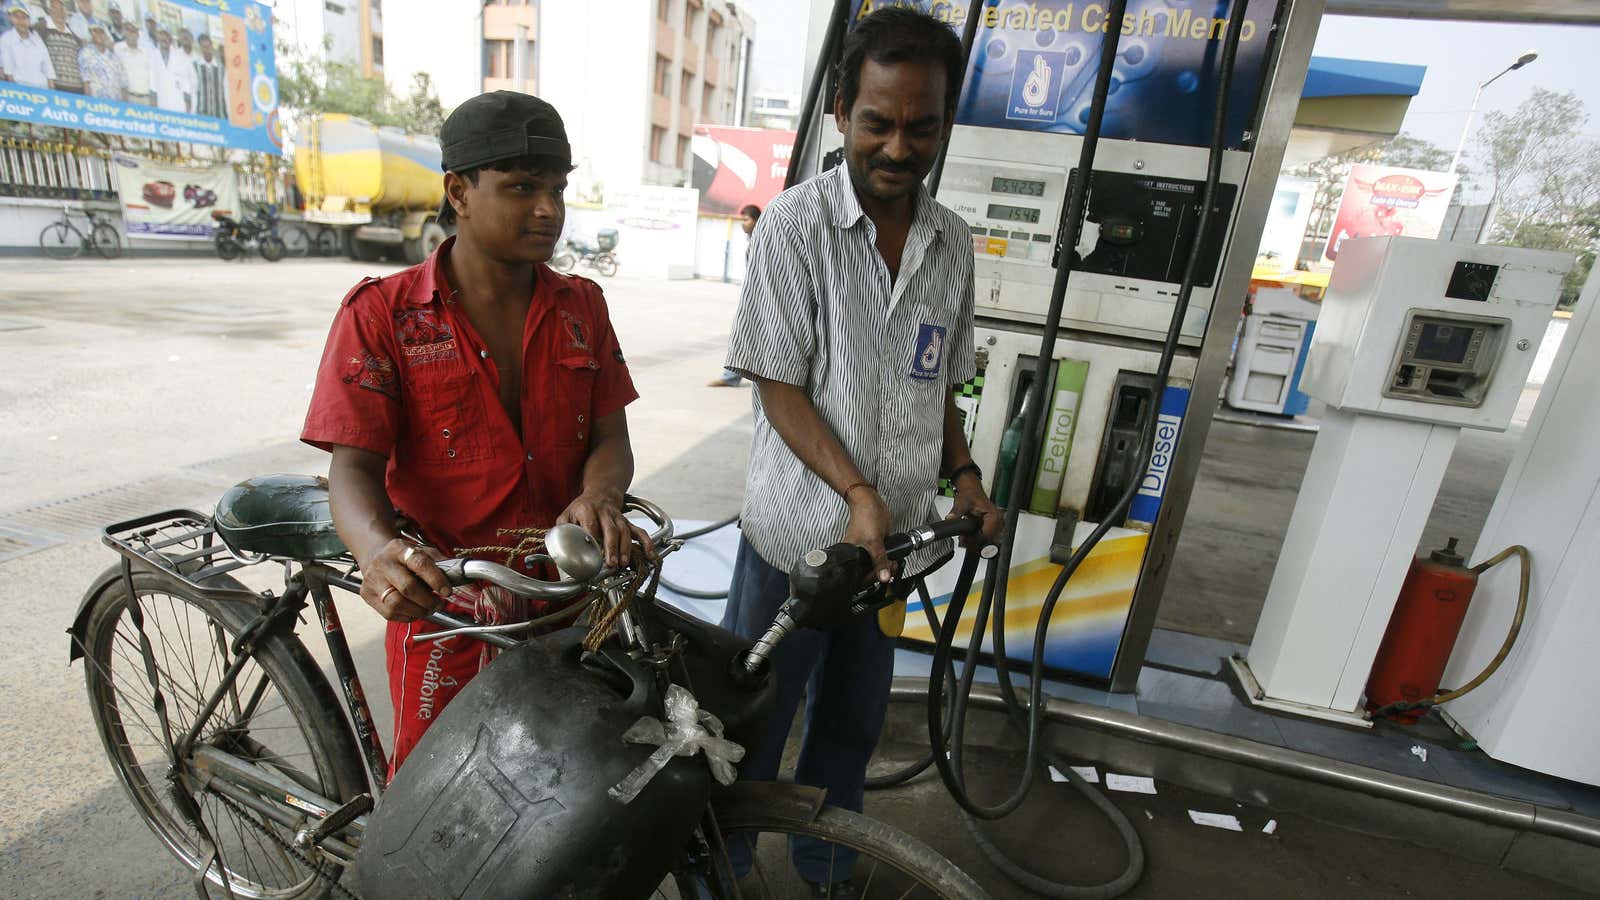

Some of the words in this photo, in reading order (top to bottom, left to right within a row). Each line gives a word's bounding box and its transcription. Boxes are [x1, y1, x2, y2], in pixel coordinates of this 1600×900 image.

[929, 0, 1073, 33] Geerated
[42, 106, 79, 122] Auto
[84, 112, 156, 135] Generated
[76, 99, 120, 117] Fully
[125, 107, 220, 131] Automated
[1014, 106, 1028, 115] Pure
[1029, 107, 1038, 116] for
[1039, 108, 1054, 117] Sure
[1156, 182, 1195, 191] INSTRUCTIONS
[954, 204, 977, 214] Litres
[1043, 408, 1072, 475] Petrol
[1142, 420, 1177, 492] Diesel
[418, 635, 457, 720] Vodafone
